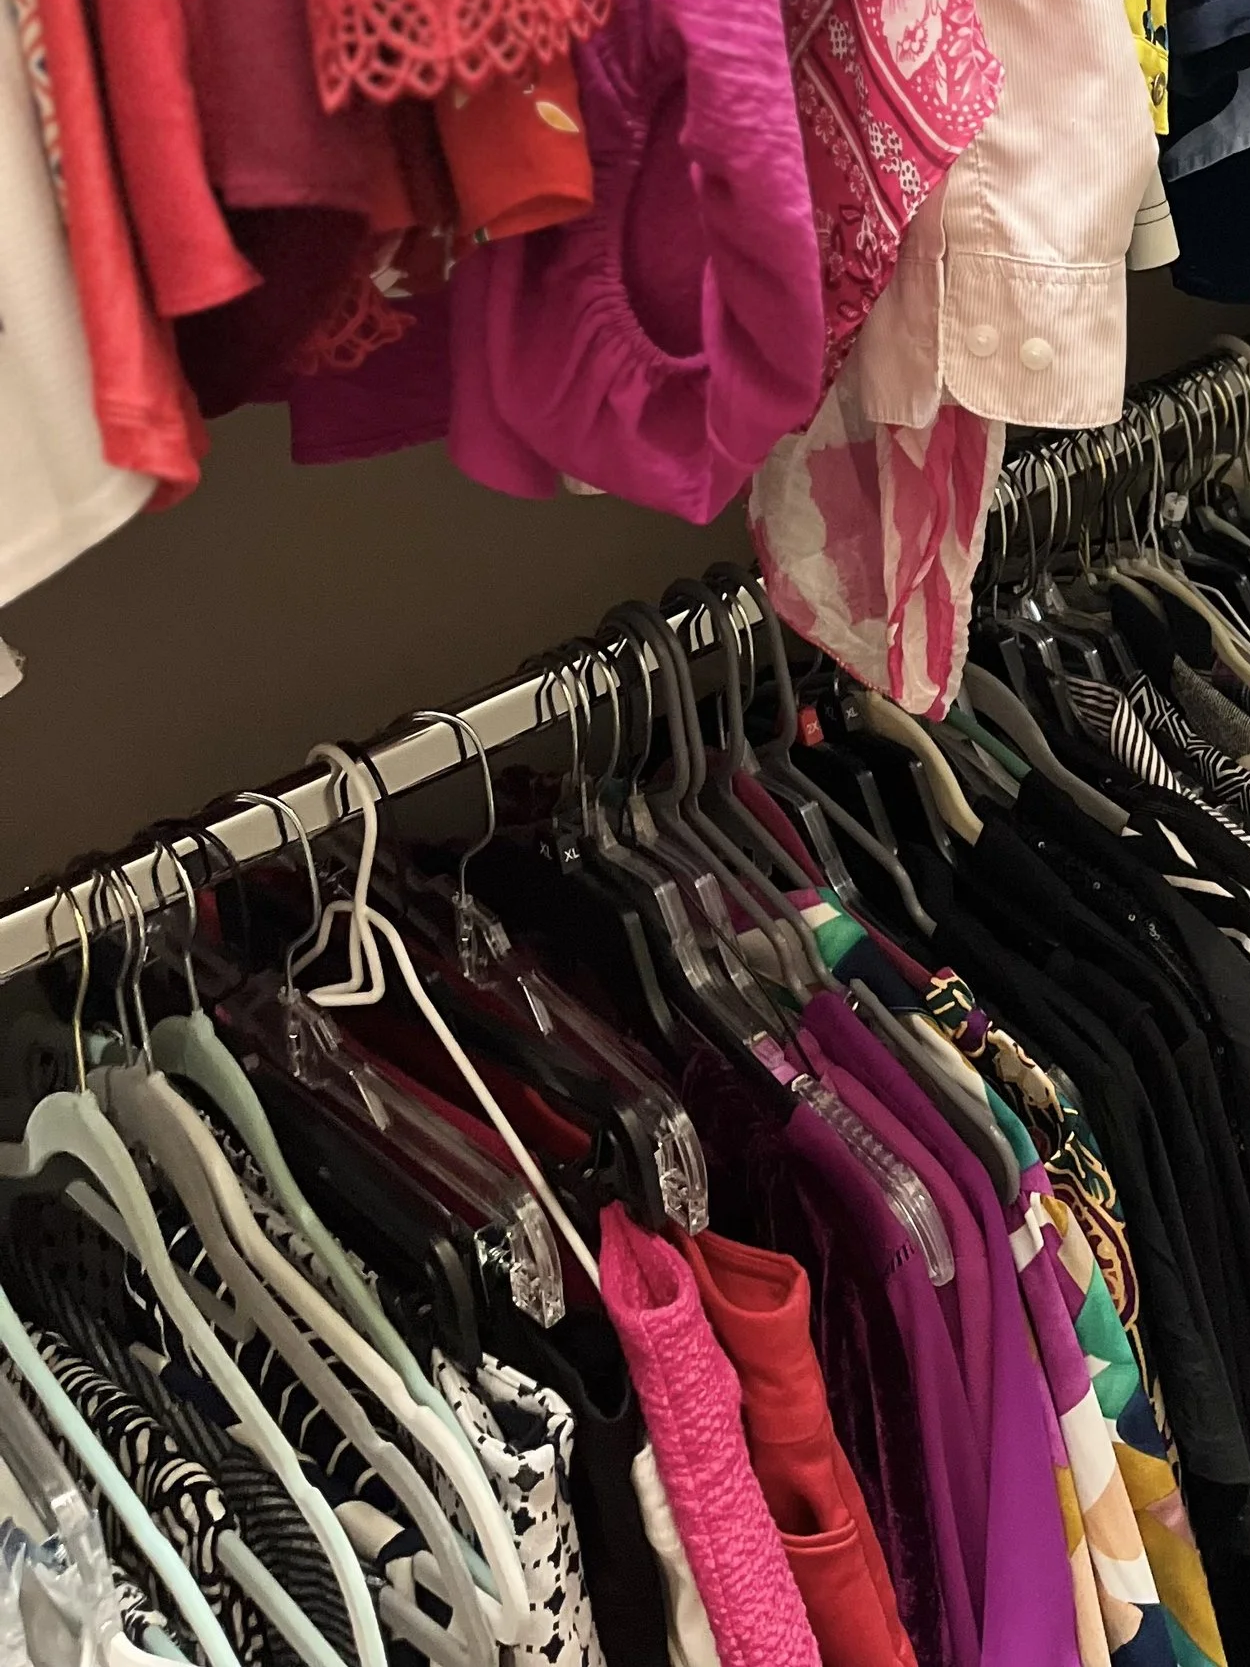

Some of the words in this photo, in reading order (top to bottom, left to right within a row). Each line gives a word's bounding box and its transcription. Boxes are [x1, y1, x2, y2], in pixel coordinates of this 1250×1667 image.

[845, 706, 860, 721] XL
[540, 839, 553, 860] XL
[563, 847, 581, 863] XL
